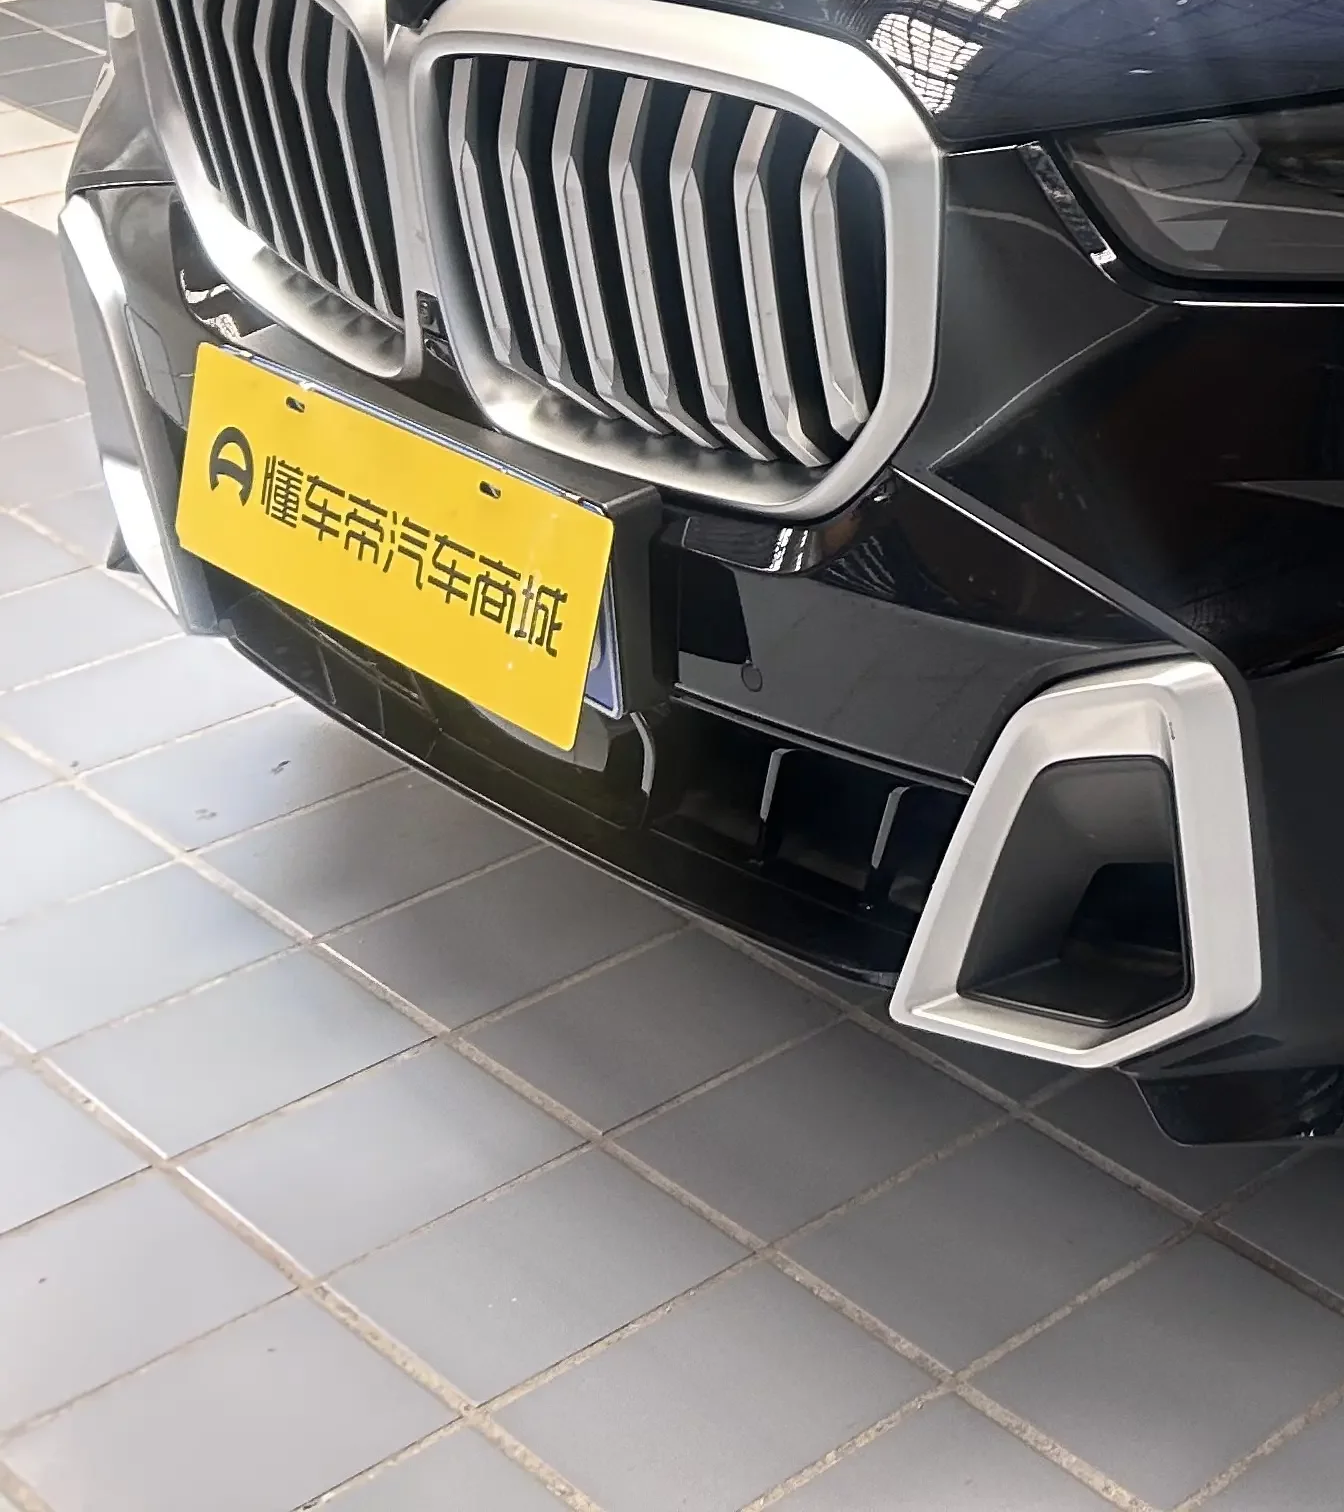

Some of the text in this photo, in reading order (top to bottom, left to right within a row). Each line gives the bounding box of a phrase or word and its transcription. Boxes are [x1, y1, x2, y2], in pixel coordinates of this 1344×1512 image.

[260, 454, 569, 657] 懂车帝汽车商城
